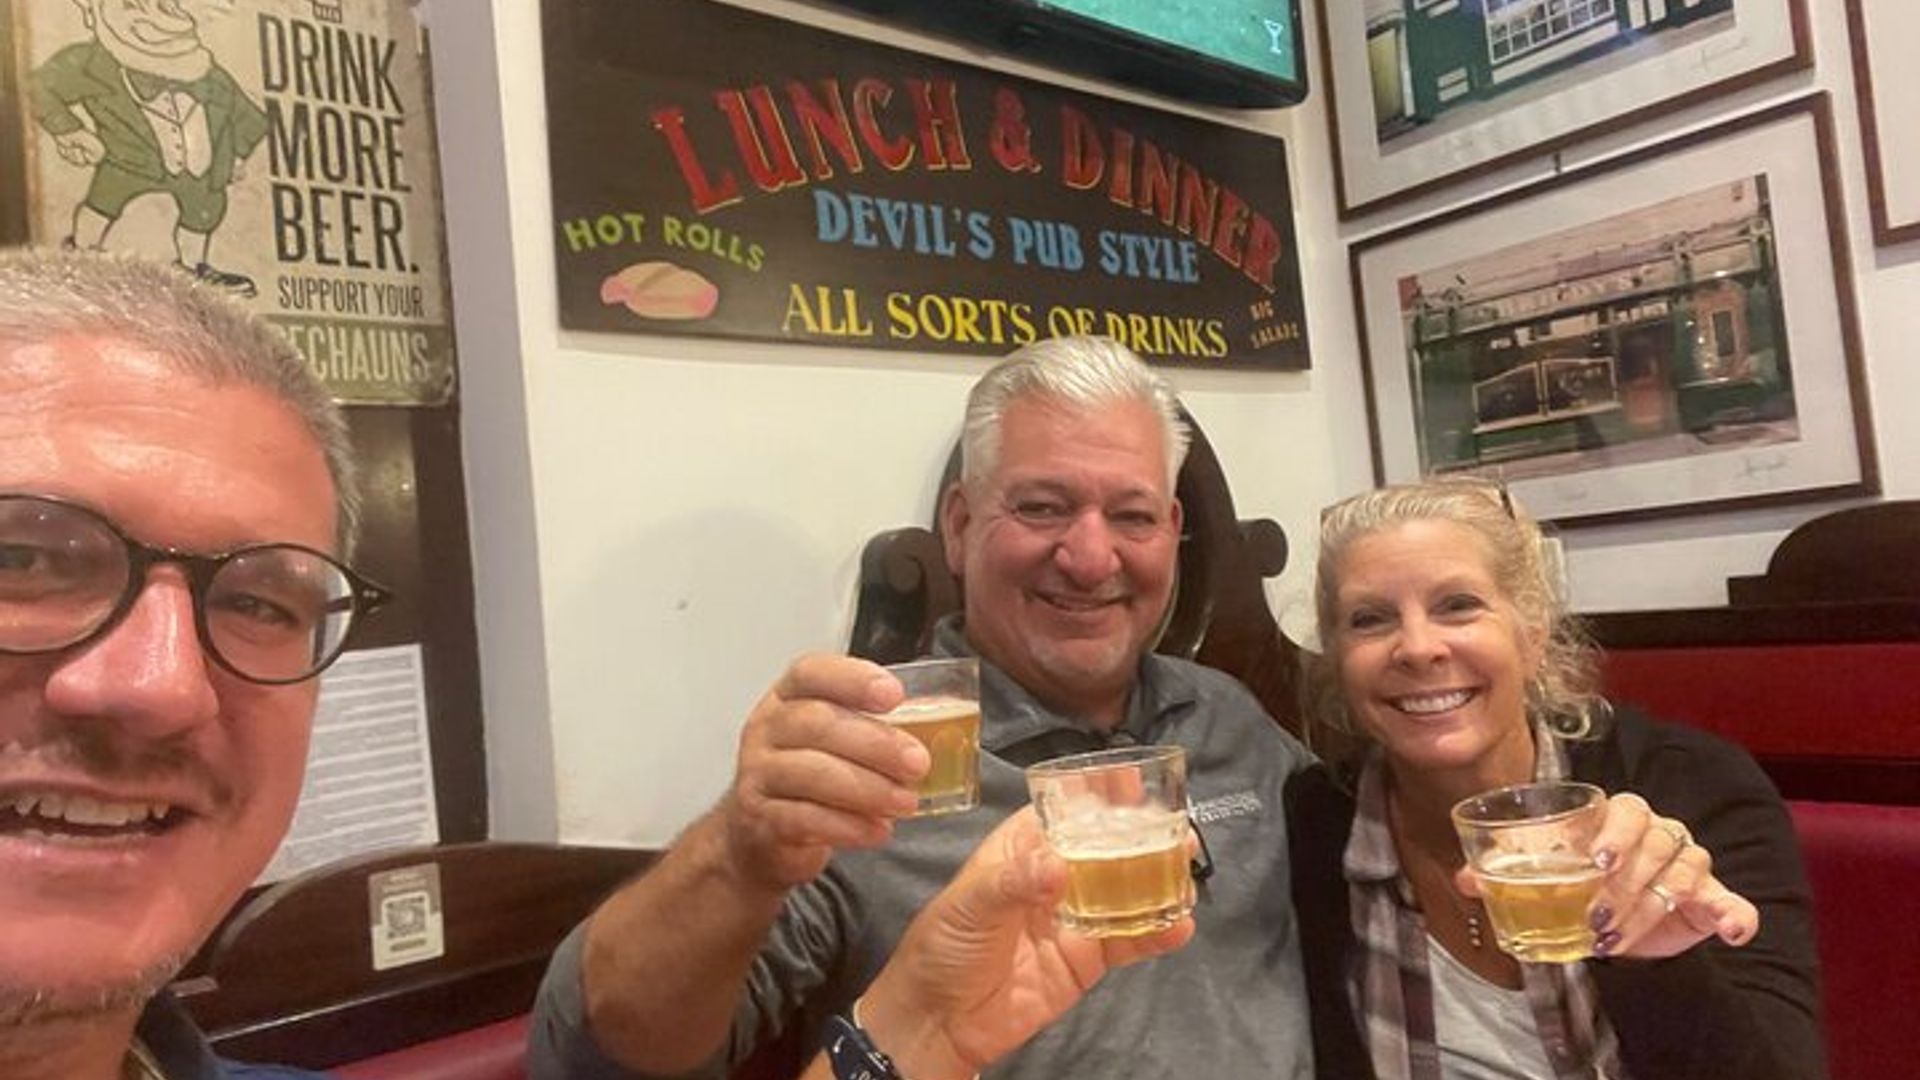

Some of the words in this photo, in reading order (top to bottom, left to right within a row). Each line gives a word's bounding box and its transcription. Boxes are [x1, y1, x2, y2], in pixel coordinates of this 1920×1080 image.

[258, 13, 404, 113] DRINK
[266, 99, 412, 193] MORE
[650, 76, 971, 213] LUNCH
[991, 88, 1041, 172] &
[1060, 105, 1281, 293] DINNER
[271, 183, 420, 274] BEER.
[564, 213, 645, 252] HOT
[663, 216, 765, 272] ROLLS
[813, 189, 996, 260] DEVIL'S
[1008, 217, 1084, 271] PUB
[1099, 230, 1199, 283] STYLE
[277, 275, 369, 315] SUPPORT
[373, 283, 425, 318] YOUR
[781, 283, 873, 336] ALL
[886, 292, 1037, 345] SORTS
[1105, 311, 1229, 358] DRINKS
